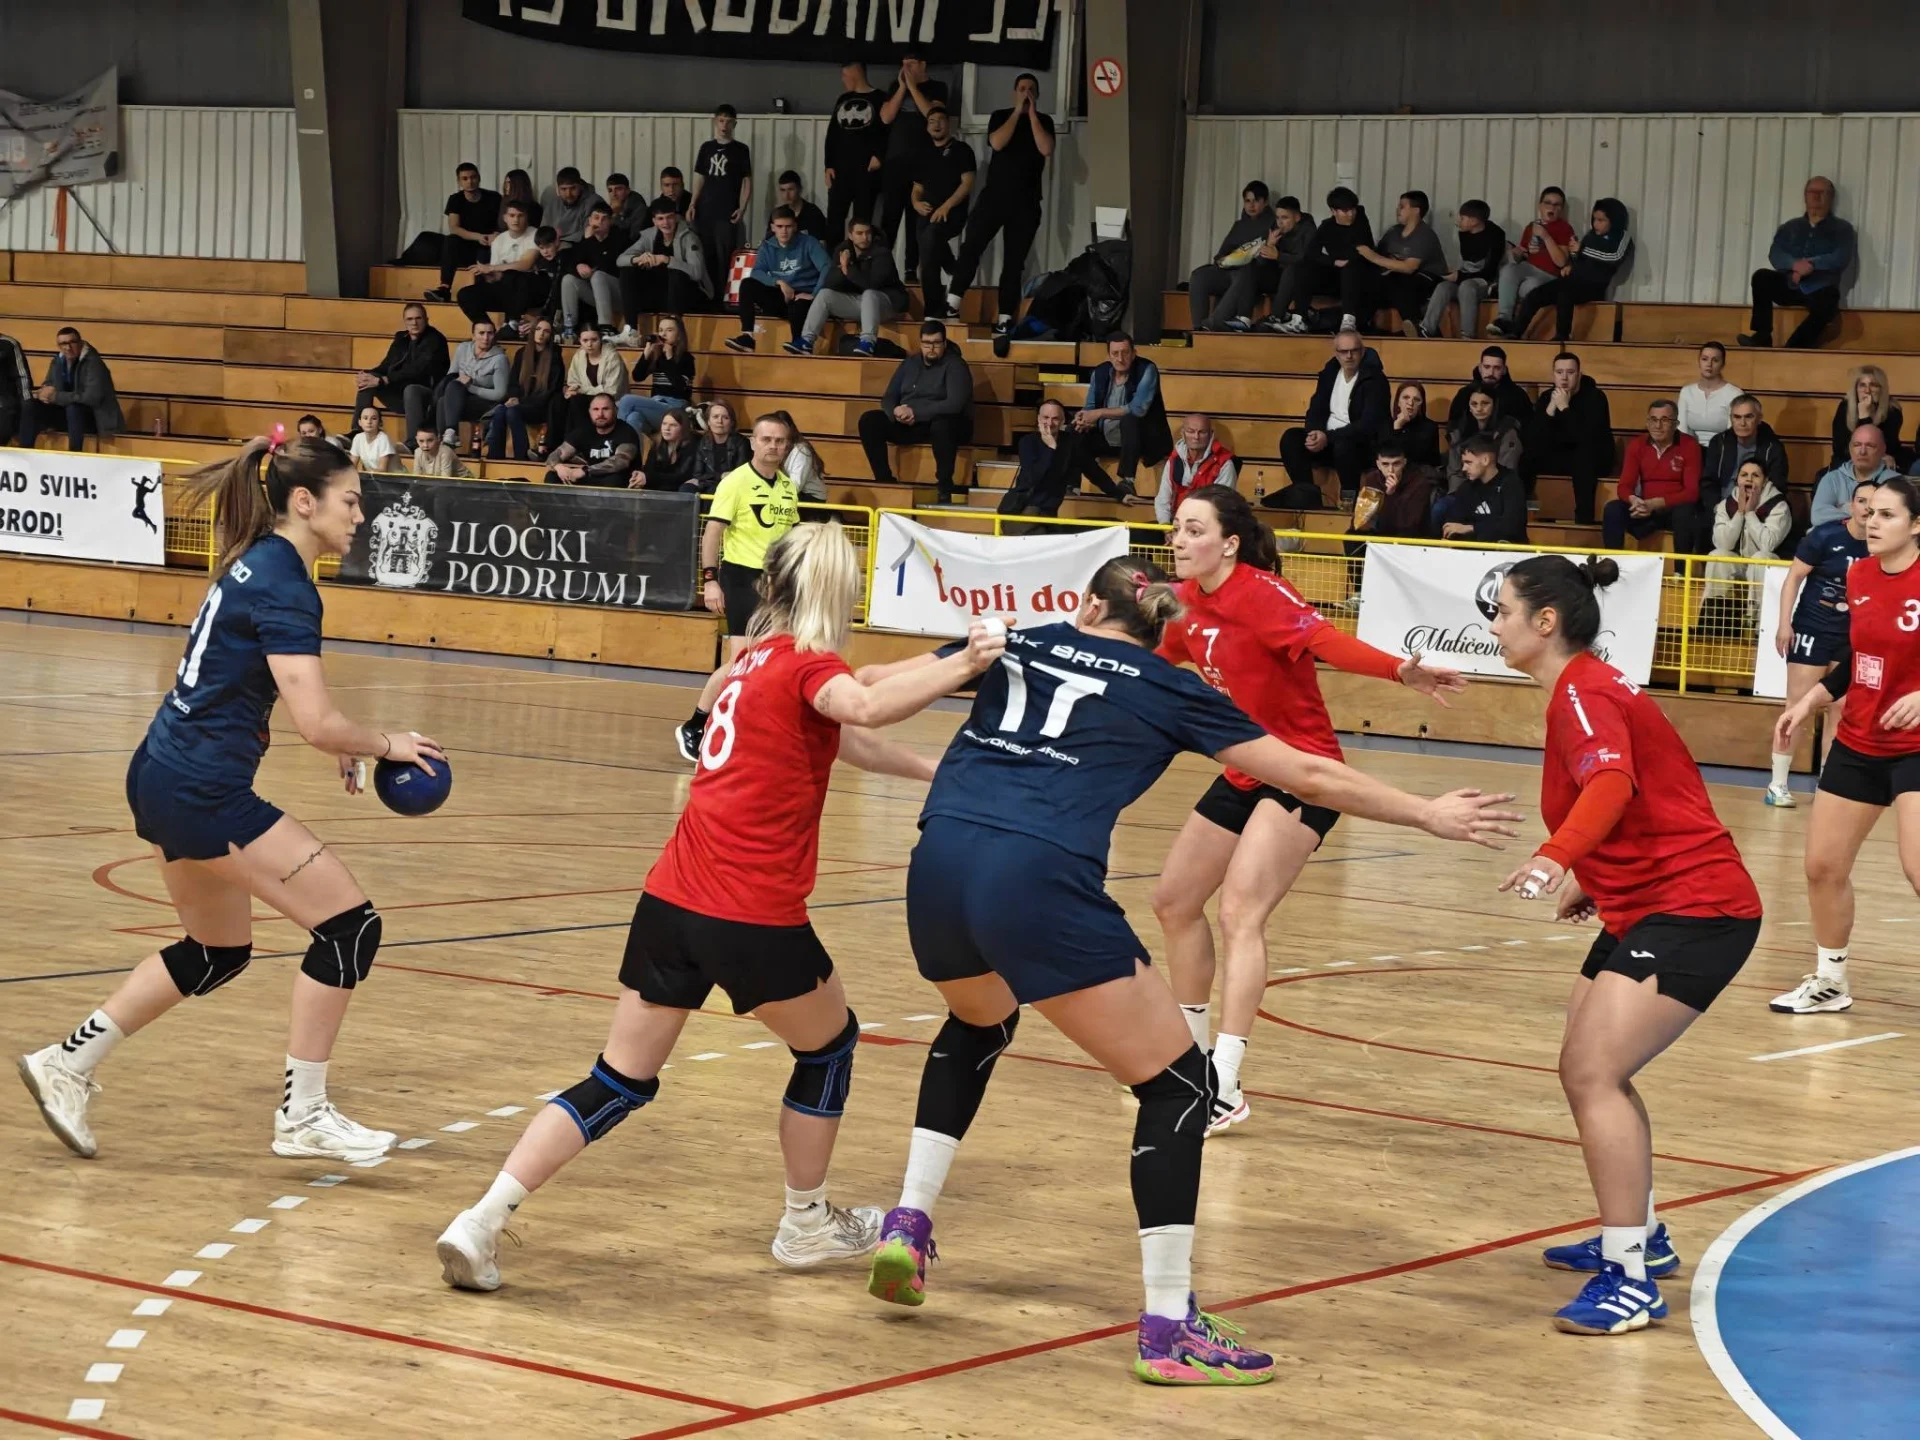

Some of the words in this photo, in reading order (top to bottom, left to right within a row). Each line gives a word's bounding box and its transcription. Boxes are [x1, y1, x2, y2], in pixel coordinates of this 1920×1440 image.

[40, 474, 97, 500] SVIH:
[448, 512, 591, 564] ILOČKI
[443, 560, 651, 606] PODRUMI
[1031, 584, 1080, 613] do
[1202, 628, 1220, 666] 7
[1793, 633, 1815, 657] 14
[999, 652, 1108, 739] 17
